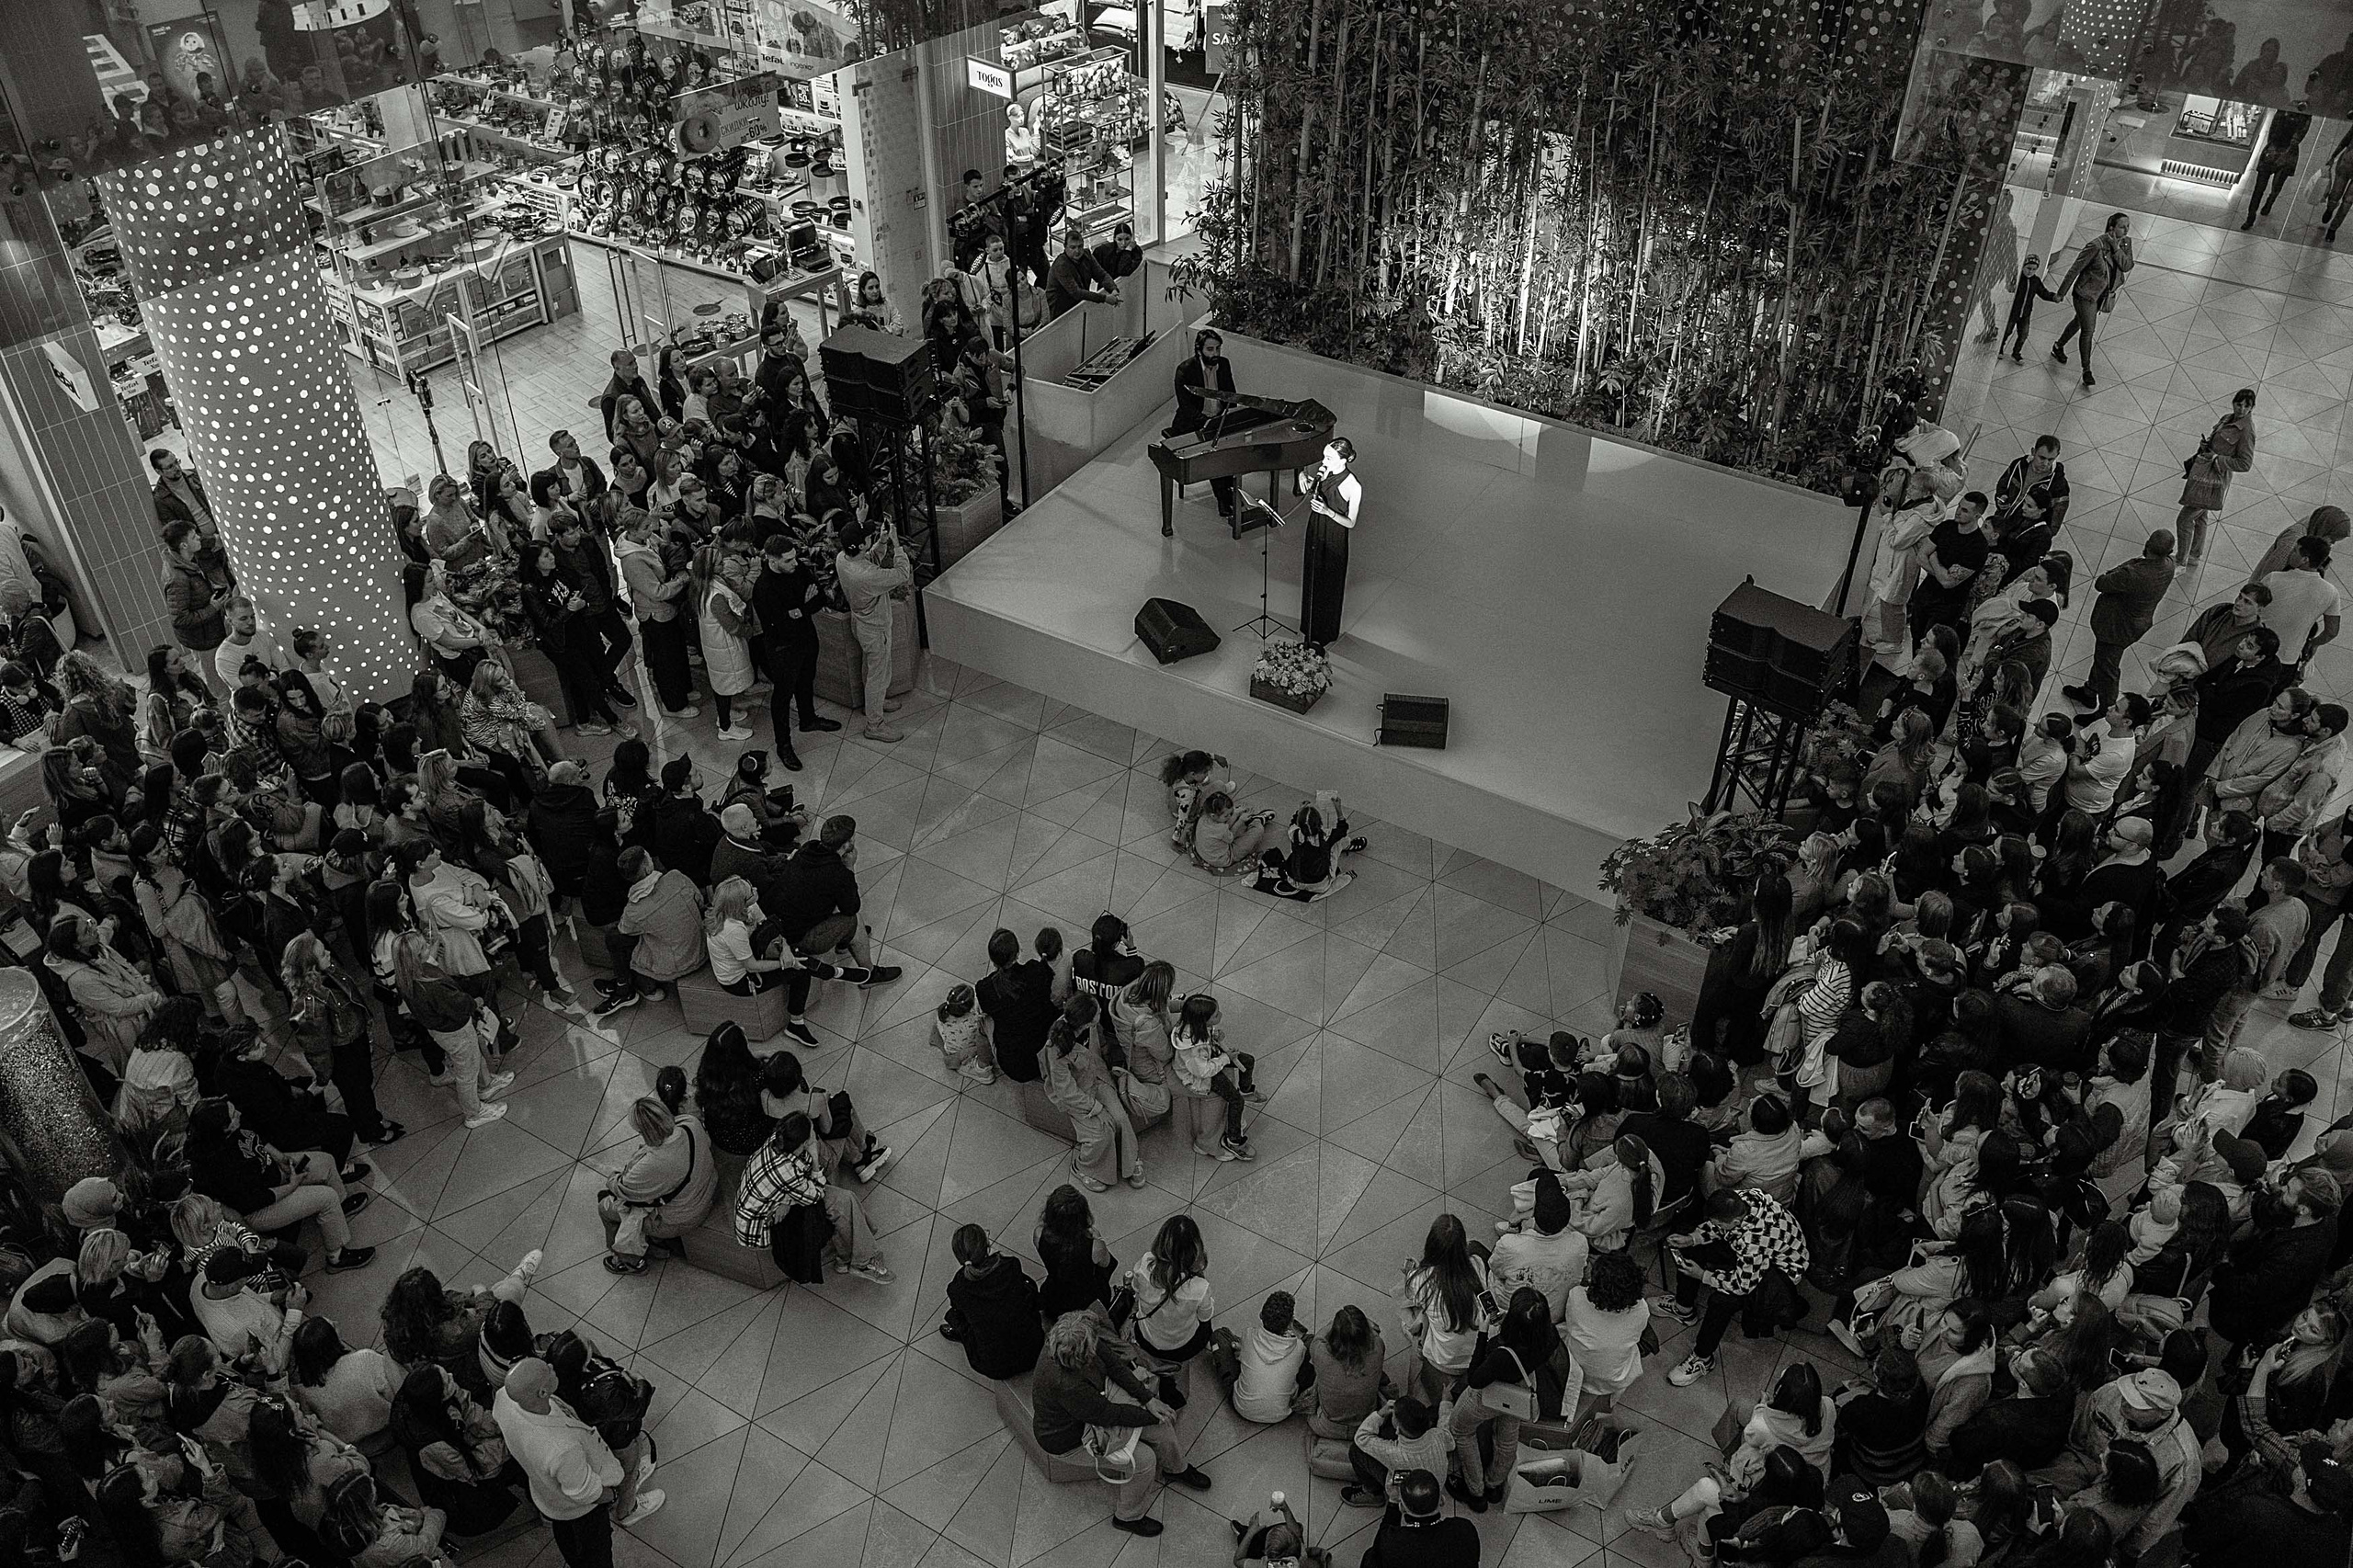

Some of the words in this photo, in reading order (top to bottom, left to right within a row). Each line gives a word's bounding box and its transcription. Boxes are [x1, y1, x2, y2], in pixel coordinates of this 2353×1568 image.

[761, 53, 785, 65] Tefal
[976, 71, 1003, 88] Togas
[734, 93, 770, 111] школу!
[120, 381, 139, 392] Tefal
[1620, 1455, 1635, 1474] LIME
